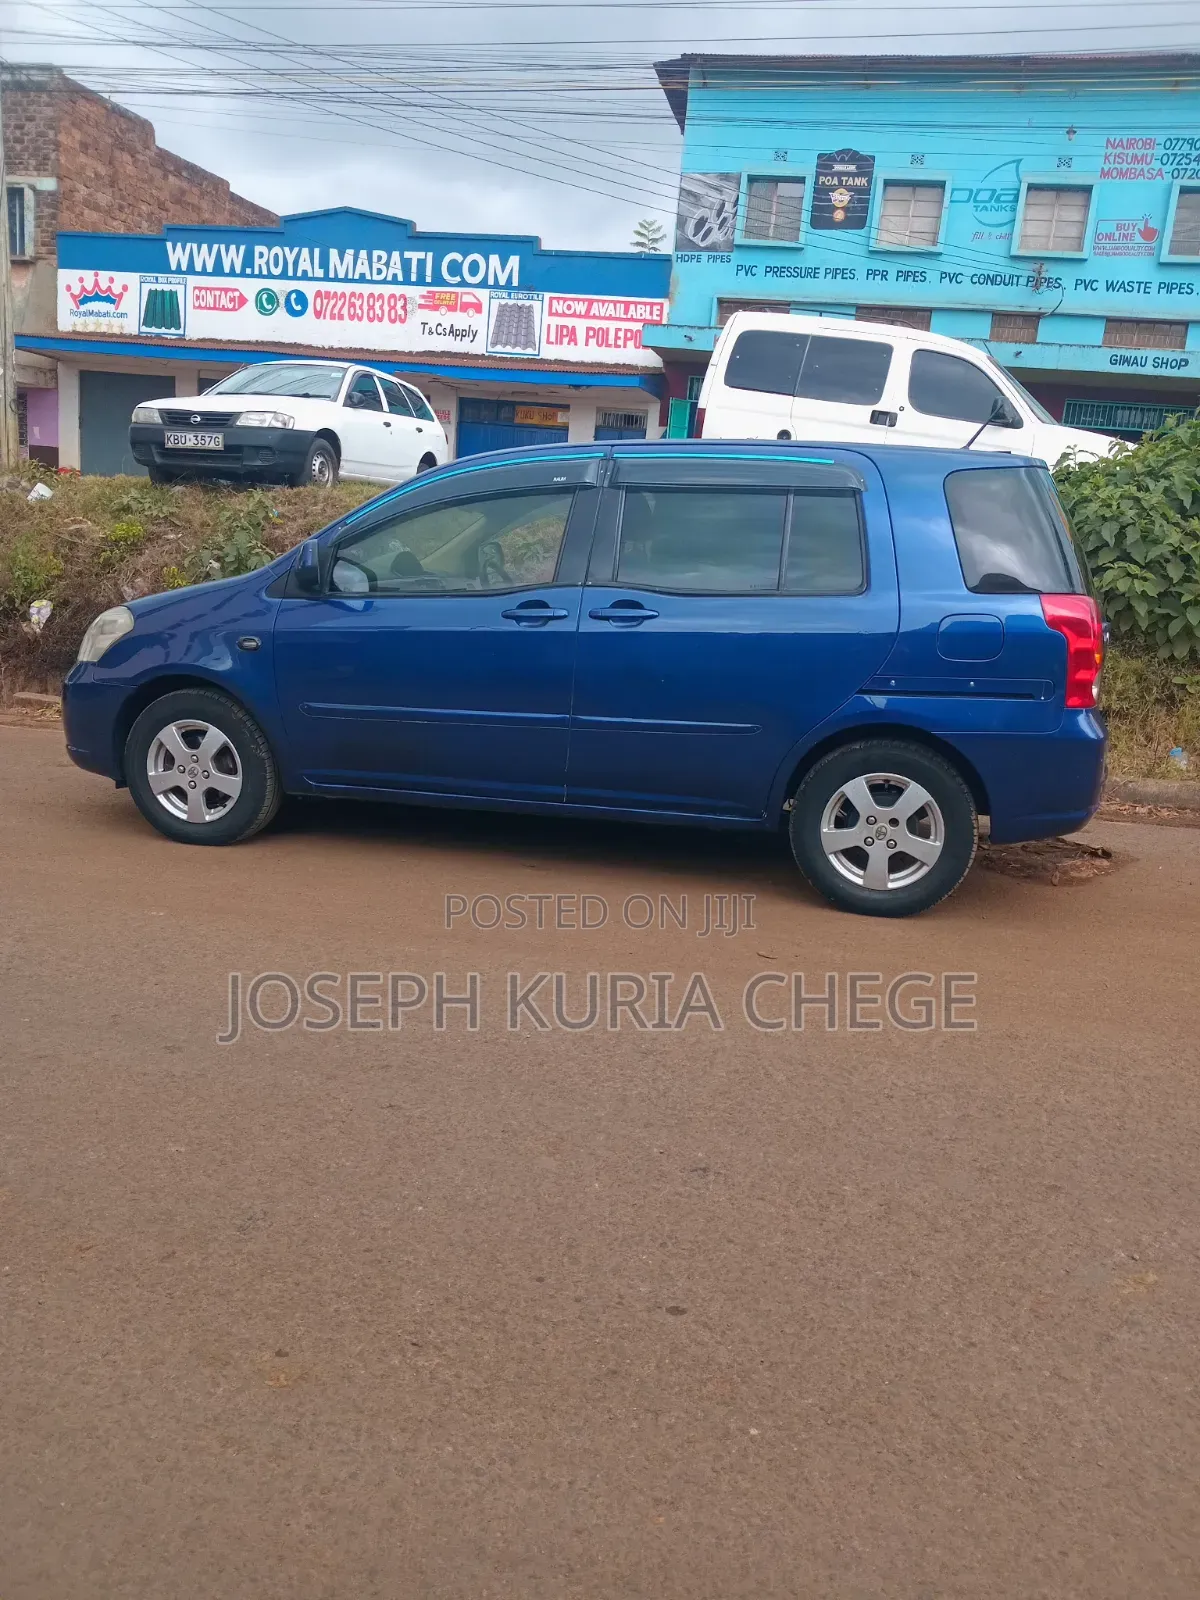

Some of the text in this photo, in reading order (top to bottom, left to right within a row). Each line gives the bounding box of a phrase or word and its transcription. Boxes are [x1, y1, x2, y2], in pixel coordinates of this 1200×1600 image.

[819, 176, 868, 187] POA TANK
[1116, 223, 1138, 231] BUY
[1097, 232, 1136, 241] ONLINE
[676, 254, 731, 264] HDPE PIPES
[736, 265, 757, 277] PVC
[764, 266, 820, 279] PRESSURE
[866, 270, 889, 281] PPR
[940, 272, 963, 284] PVC
[970, 274, 1022, 287] CONDUIT
[1074, 279, 1099, 291] PVC
[1106, 280, 1152, 294] WASTE
[193, 289, 240, 309] CONTACT
[69, 309, 128, 318] RoyalMabati.com
[552, 300, 660, 320] NOW AVAILABLE
[546, 324, 578, 346] LIPA
[1109, 354, 1189, 370] GIWAU SHOP
[166, 434, 221, 446] KBU 357G
